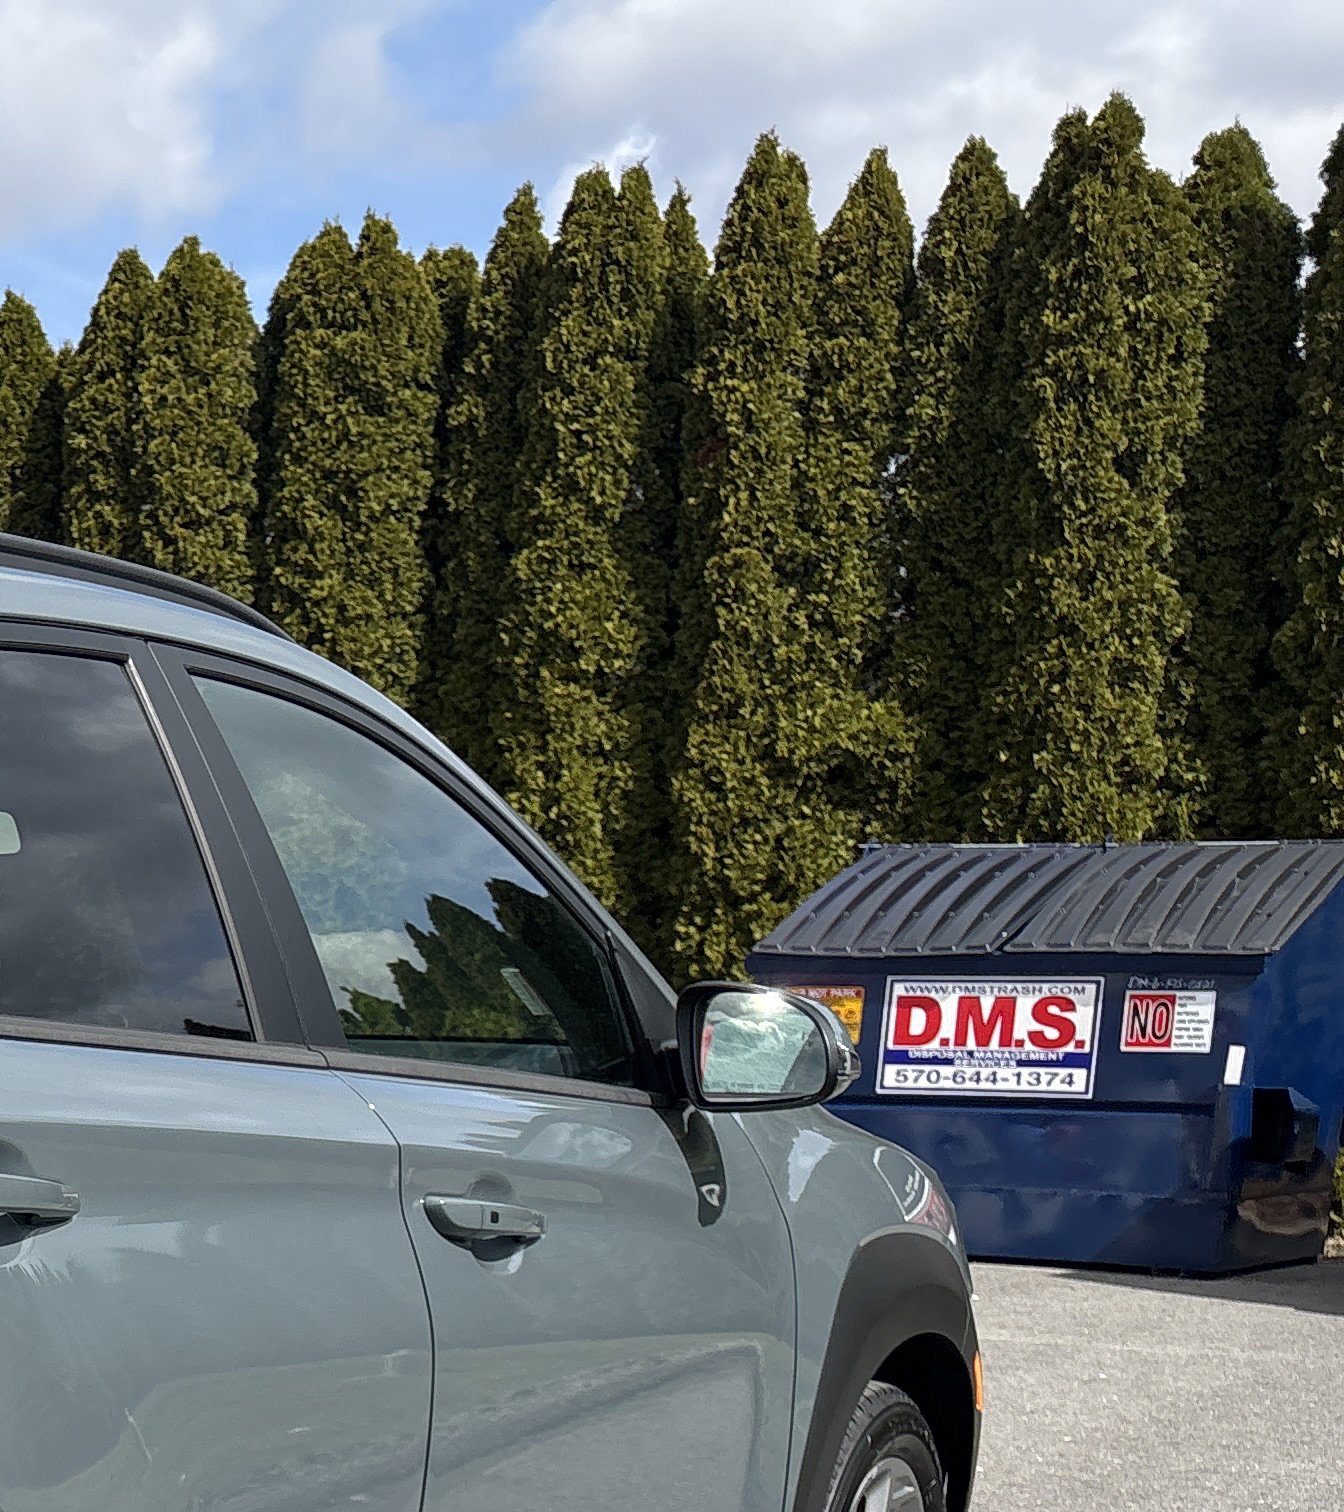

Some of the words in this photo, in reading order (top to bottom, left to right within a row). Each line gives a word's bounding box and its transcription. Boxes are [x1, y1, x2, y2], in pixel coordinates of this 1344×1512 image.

[892, 994, 1087, 1050] D.M.S.
[1127, 998, 1172, 1044] NO
[907, 1049, 971, 1060] DISPOSAL
[974, 1050, 1065, 1062] MANAGEMENT
[893, 1068, 1076, 1088] 570-644-1374
